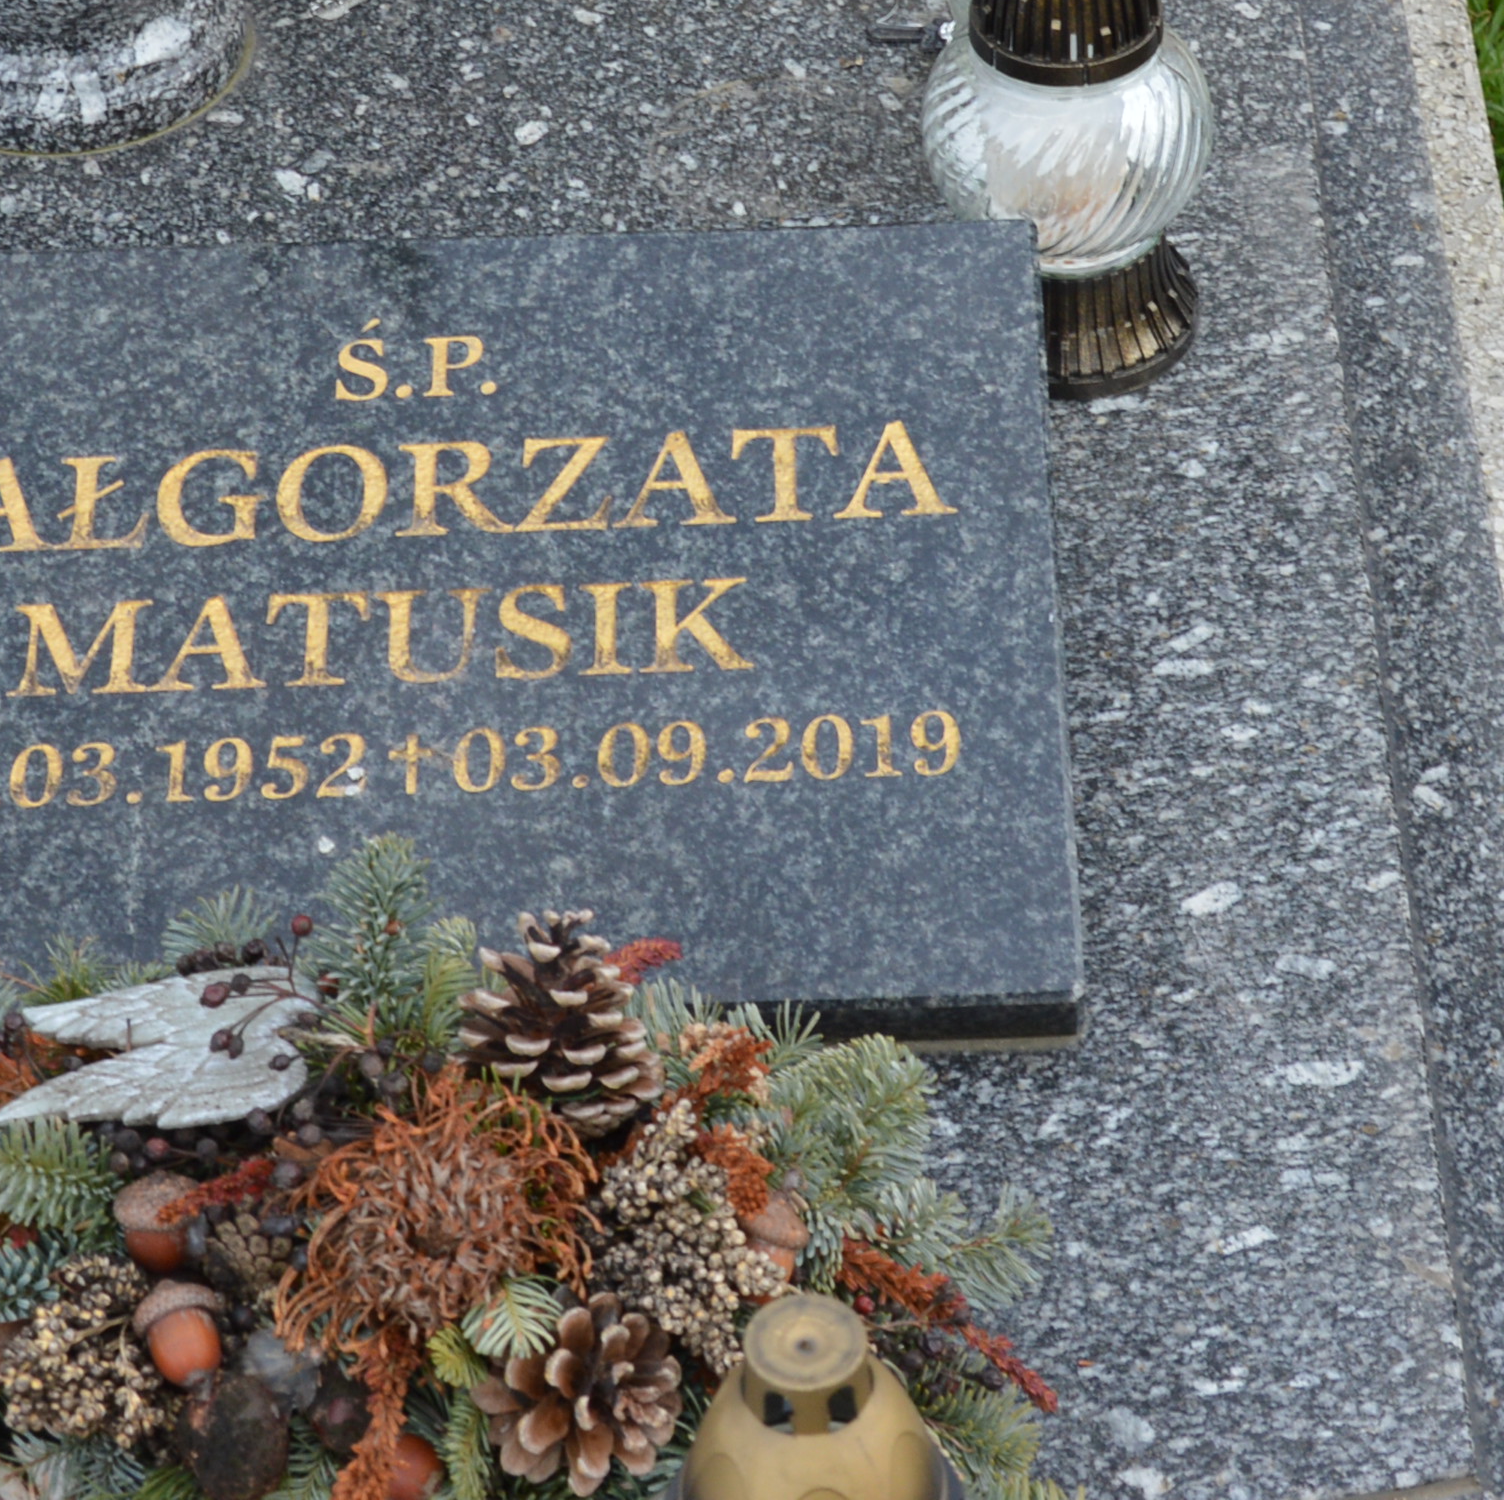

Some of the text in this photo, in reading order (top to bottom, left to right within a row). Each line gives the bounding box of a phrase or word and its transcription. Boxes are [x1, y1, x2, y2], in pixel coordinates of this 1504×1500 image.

[334, 317, 499, 403] Ś.P.
[7, 576, 753, 697] MATUSIK
[452, 708, 963, 794] 03.09.2019
